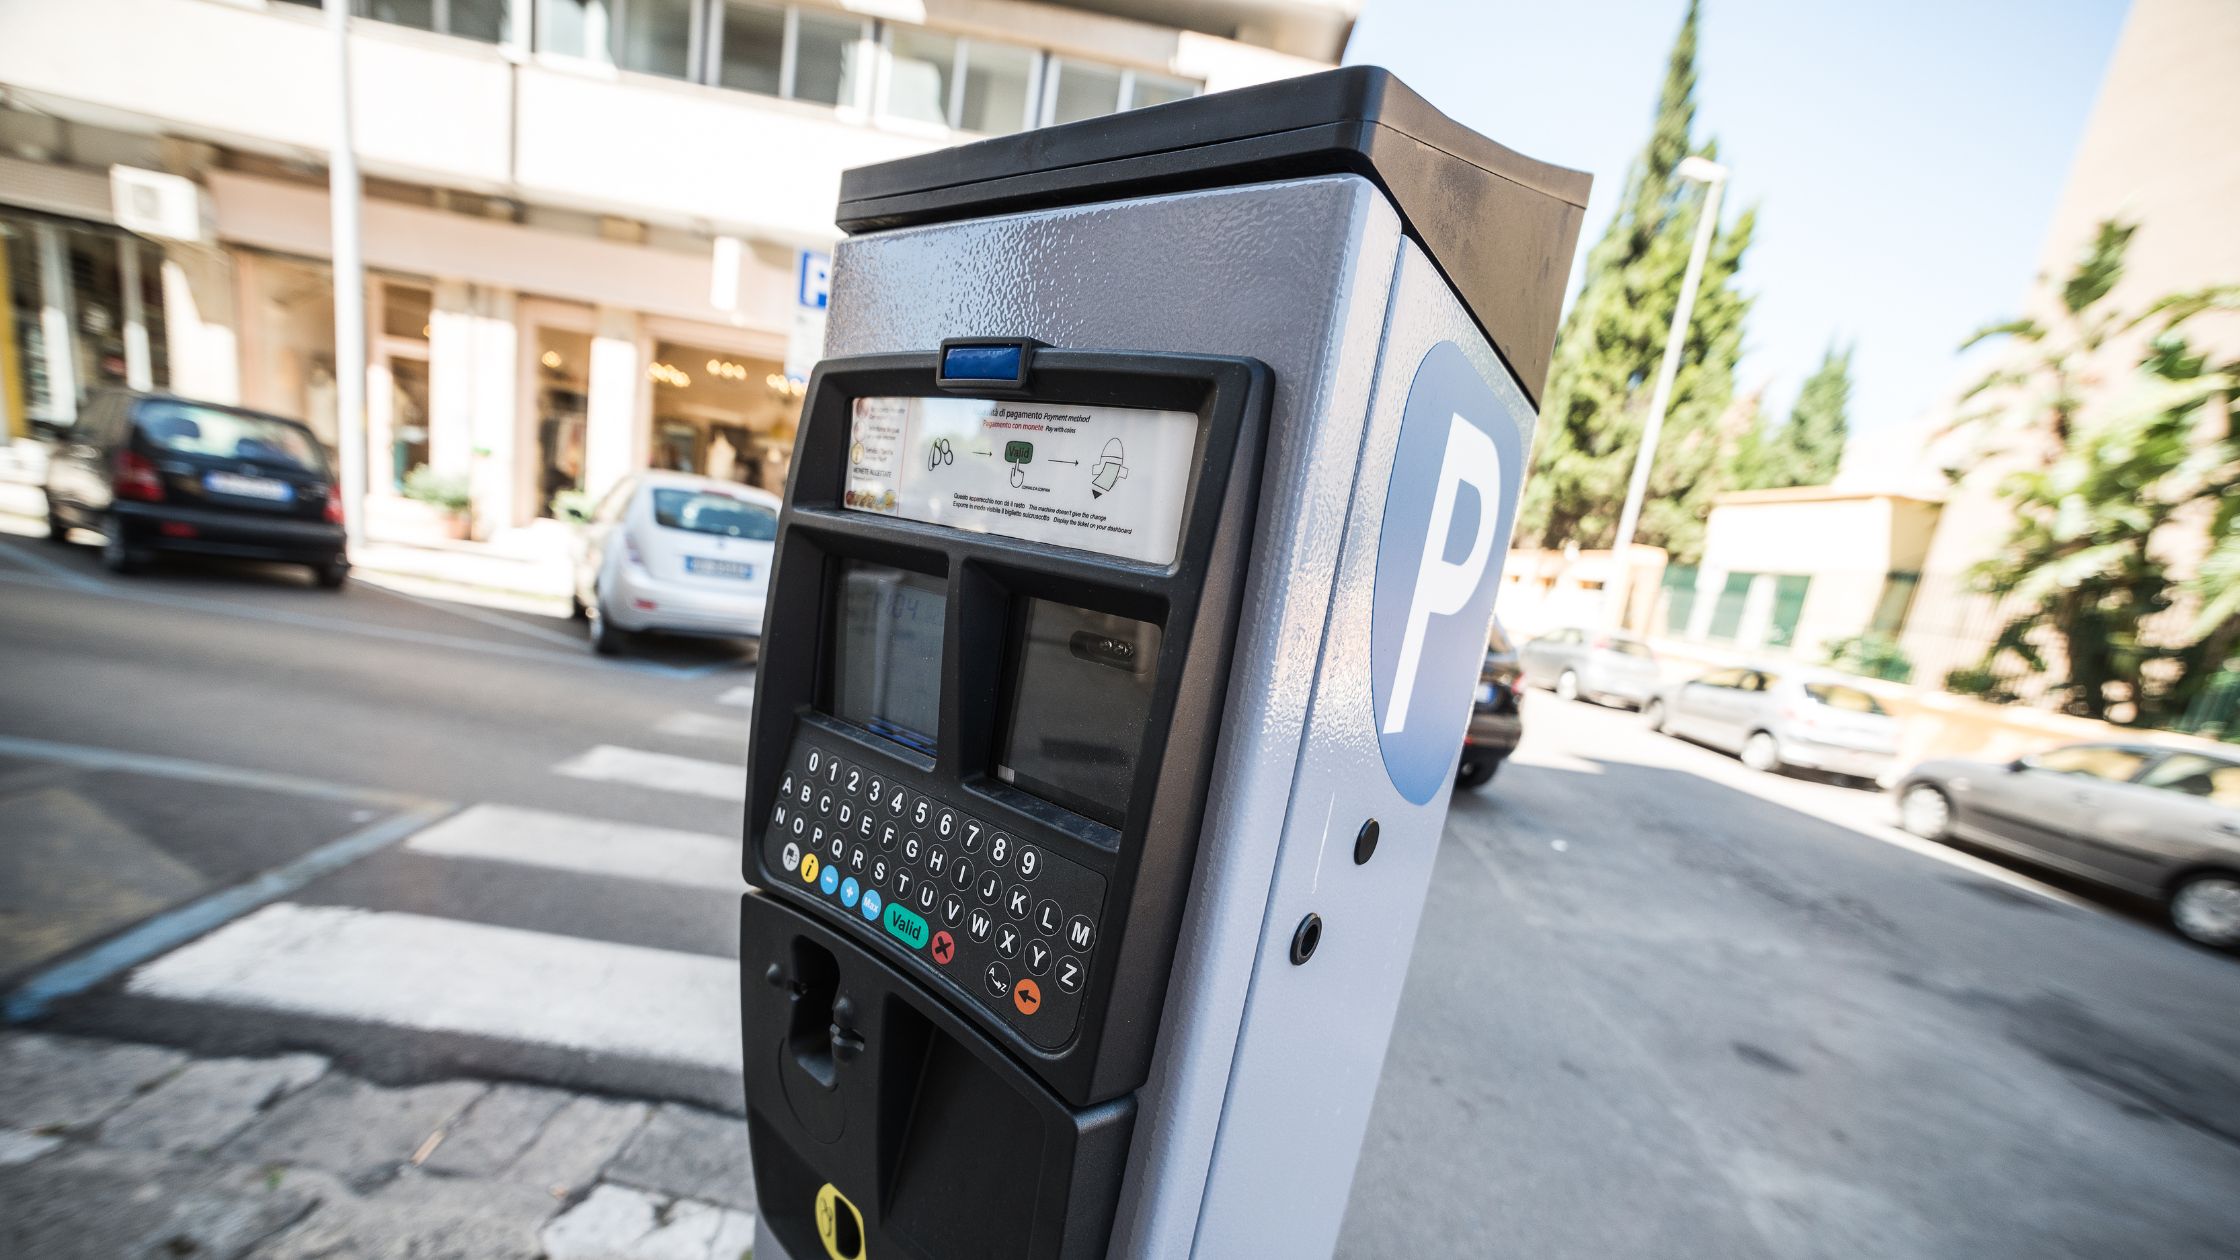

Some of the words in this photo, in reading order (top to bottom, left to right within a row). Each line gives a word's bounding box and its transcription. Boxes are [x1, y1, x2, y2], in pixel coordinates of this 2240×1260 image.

[1006, 410, 1042, 420] pagamento
[1044, 413, 1068, 422] Payment
[1067, 414, 1091, 423] method
[983, 420, 1011, 429] Pagamento
[1045, 425, 1054, 434] Pay
[1009, 445, 1030, 458] Valid
[954, 492, 968, 501] Questo
[969, 495, 994, 504] apparecchio
[1005, 508, 1021, 517] biglietto
[1090, 513, 1106, 522] change
[1053, 516, 1069, 525] Display
[1107, 525, 1132, 534] dashboard
[1383, 412, 1501, 734] P
[848, 772, 859, 791] 2
[870, 781, 880, 801] 3
[892, 793, 903, 812] 4
[916, 802, 927, 823] 5
[940, 814, 952, 835] 6
[967, 825, 979, 846] 7
[993, 839, 1006, 860] 8
[1022, 852, 1035, 874] 9
[783, 777, 791, 793] A
[801, 785, 811, 802] B
[821, 796, 830, 812] C
[840, 805, 850, 822] D
[861, 816, 872, 834] E
[884, 827, 894, 843] F
[906, 840, 918, 857] G
[930, 851, 943, 871] H
[984, 880, 995, 896] J
[1011, 891, 1026, 914] K
[1042, 907, 1052, 929] L
[1072, 922, 1090, 946] M
[776, 807, 785, 824] N
[813, 827, 822, 842] P
[832, 839, 842, 858] Q
[852, 850, 863, 868] R
[875, 863, 885, 880] S
[900, 874, 909, 892] T
[922, 887, 933, 906] U
[949, 900, 960, 920] V
[972, 914, 989, 937] W
[1000, 930, 1015, 953] X
[1034, 946, 1046, 967] Y
[1061, 963, 1077, 986] Z
[863, 897, 879, 913] Max
[892, 910, 922, 941] Valid
[989, 967, 995, 976] A
[1000, 983, 1007, 992] Z
